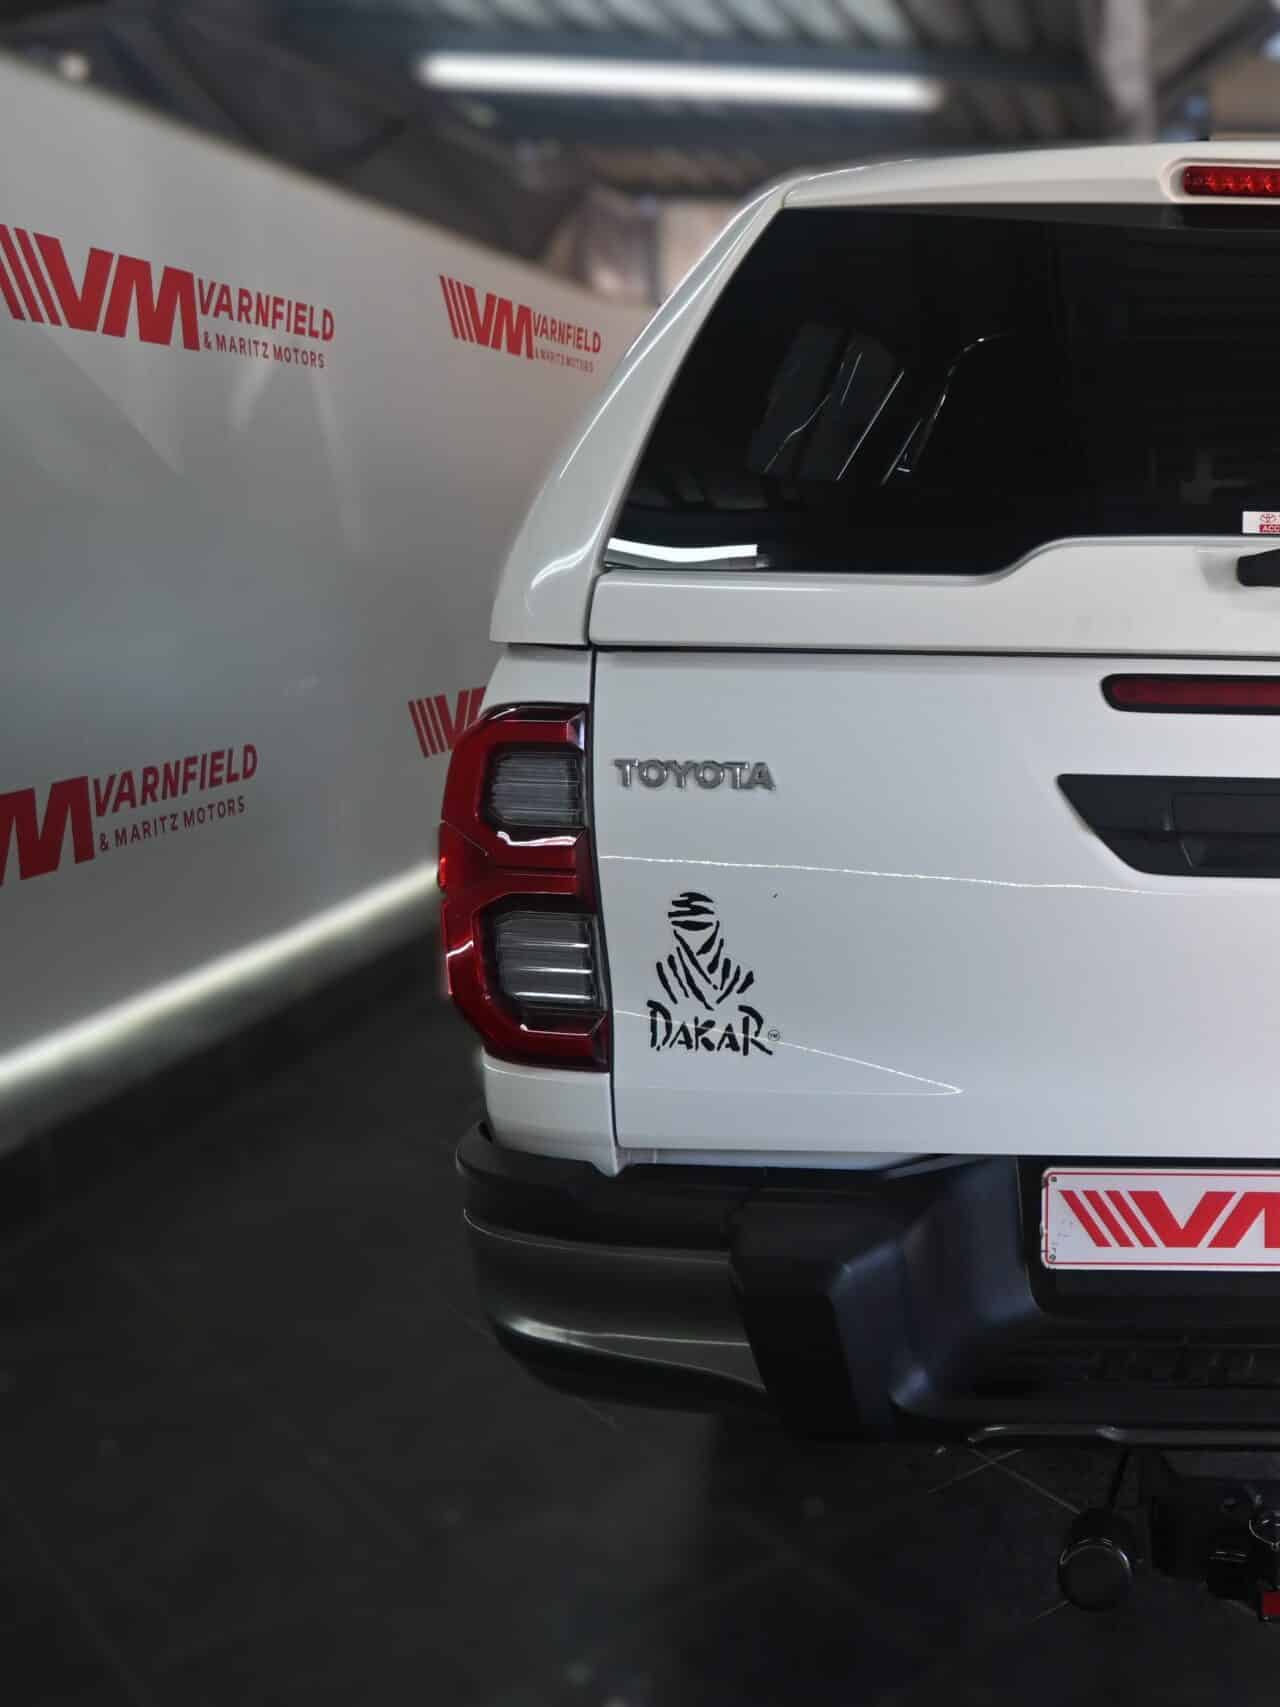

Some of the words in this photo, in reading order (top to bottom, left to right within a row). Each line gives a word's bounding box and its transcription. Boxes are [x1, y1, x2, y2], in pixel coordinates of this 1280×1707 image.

[33, 232, 201, 351] VM
[198, 277, 334, 341] VARNFIELD
[204, 331, 213, 350] &
[216, 333, 270, 359] MARITZ
[273, 343, 325, 369] MOTORS
[463, 284, 533, 360] VM
[533, 312, 601, 353] VARNFIELD
[93, 744, 257, 817] VARNFIELD
[613, 759, 776, 790] TOYOTA
[100, 832, 109, 851] &
[115, 813, 179, 848] MARITZ
[183, 795, 245, 828] MOTORS
[647, 1000, 773, 1056] DAKAR
